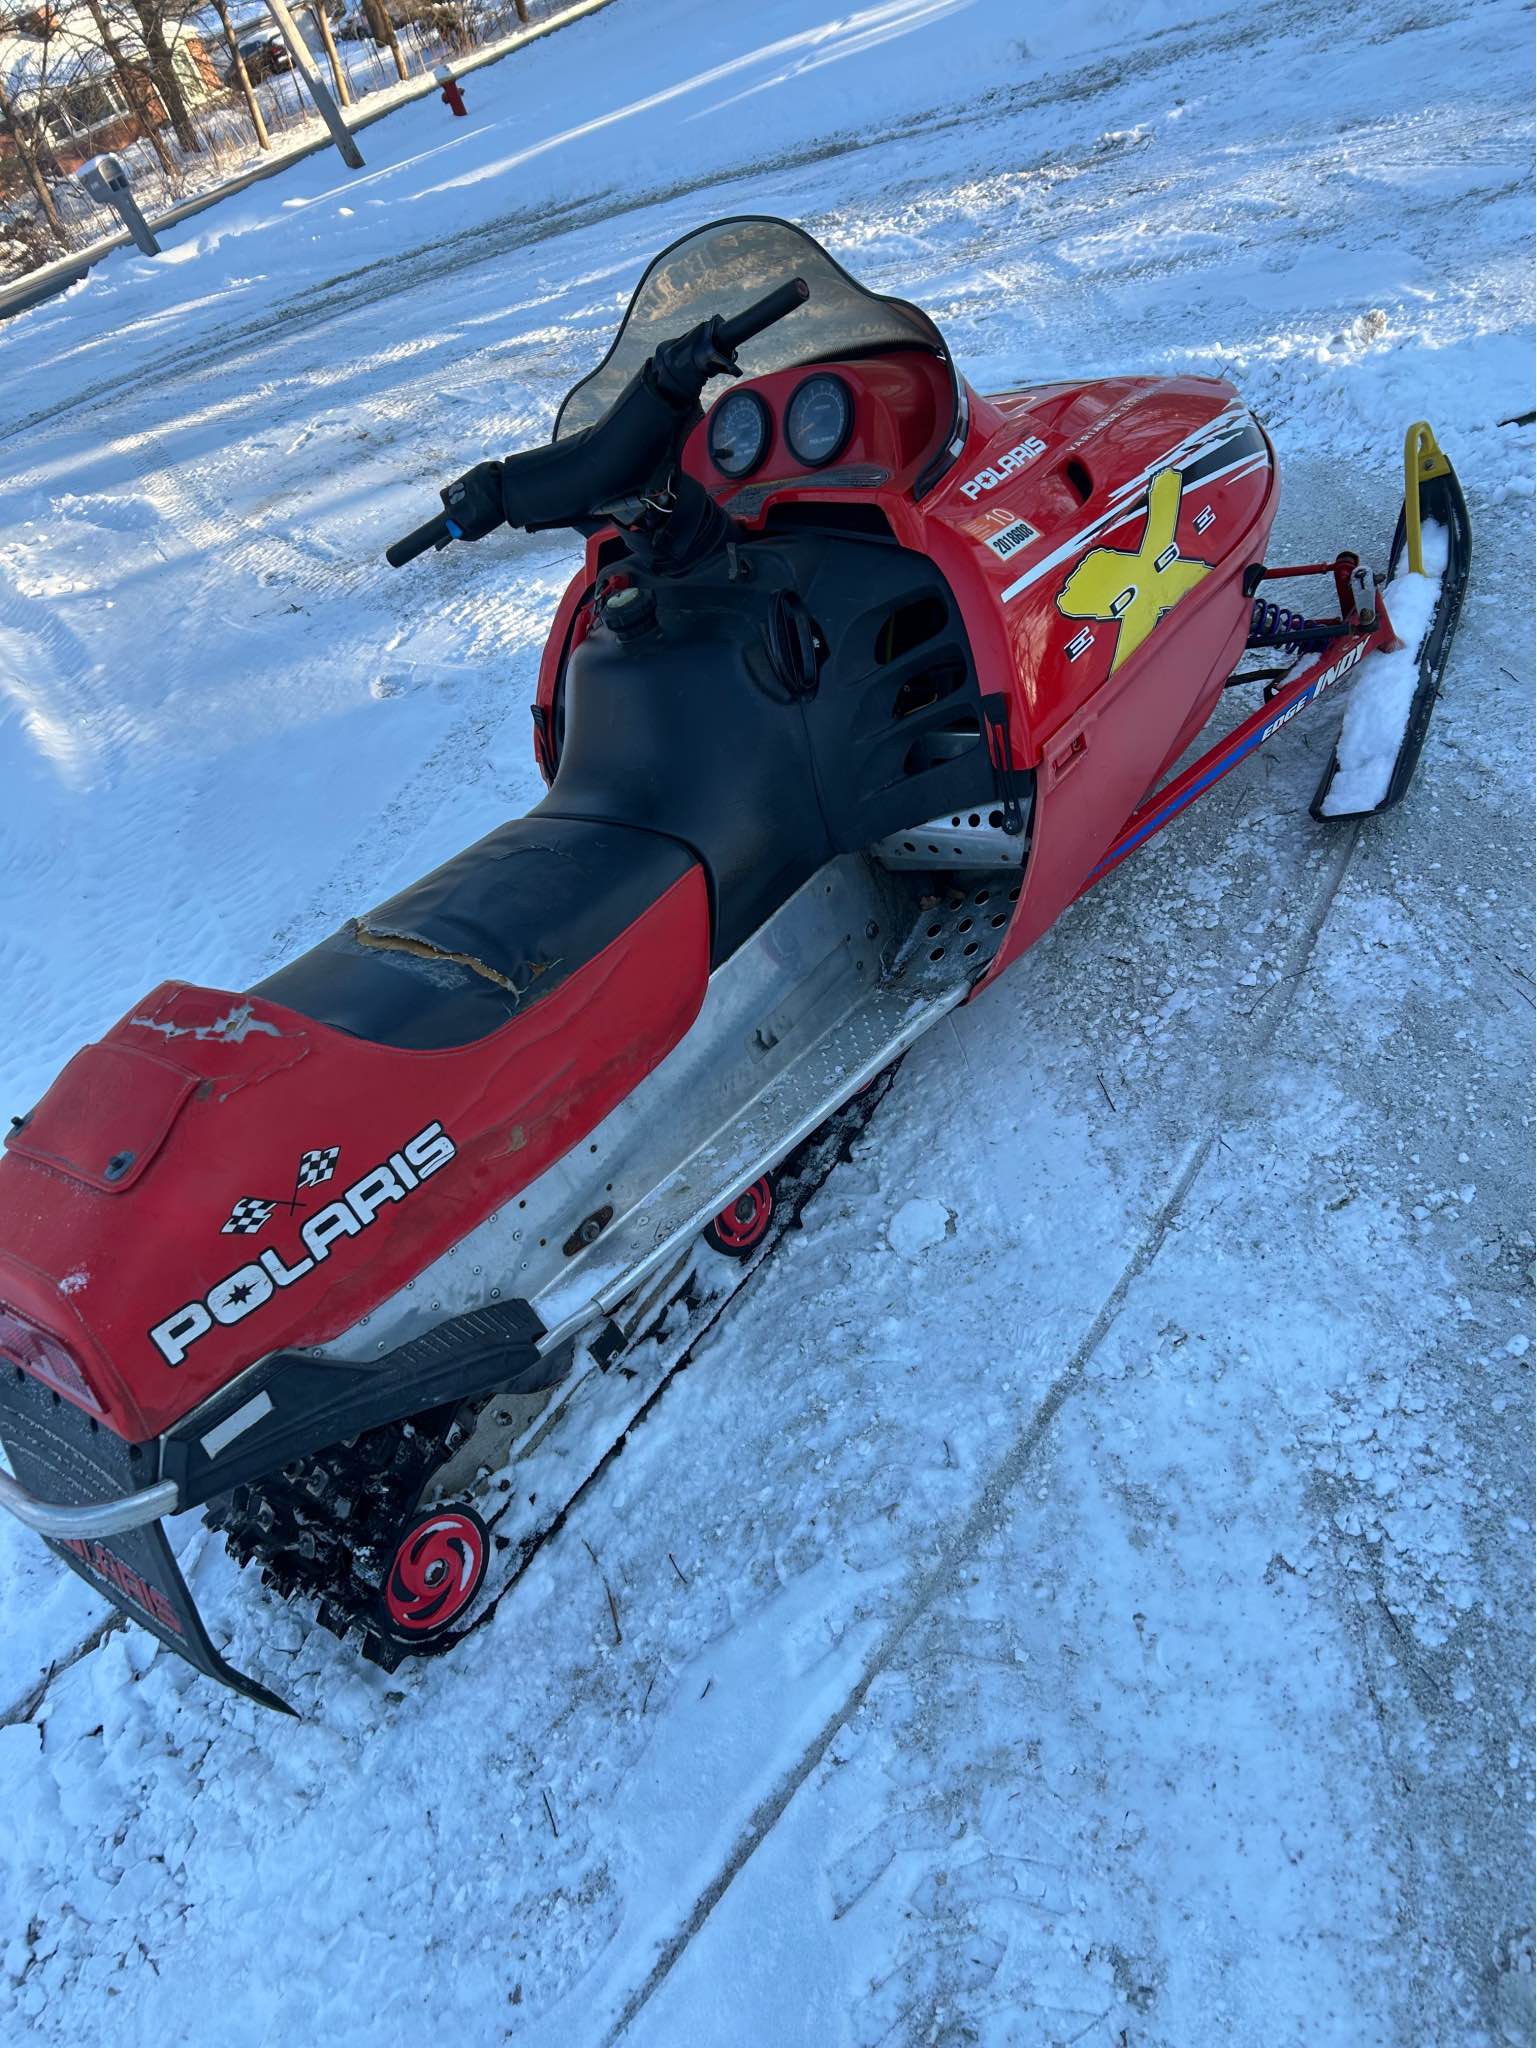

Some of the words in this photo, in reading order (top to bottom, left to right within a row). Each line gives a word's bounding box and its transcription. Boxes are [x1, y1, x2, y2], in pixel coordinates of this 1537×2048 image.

[960, 435, 1049, 501] POLARIS
[985, 508, 1017, 527] 10
[1261, 695, 1309, 742] EDGE
[1312, 634, 1372, 699] INDY
[148, 1120, 457, 1367] POLARIS
